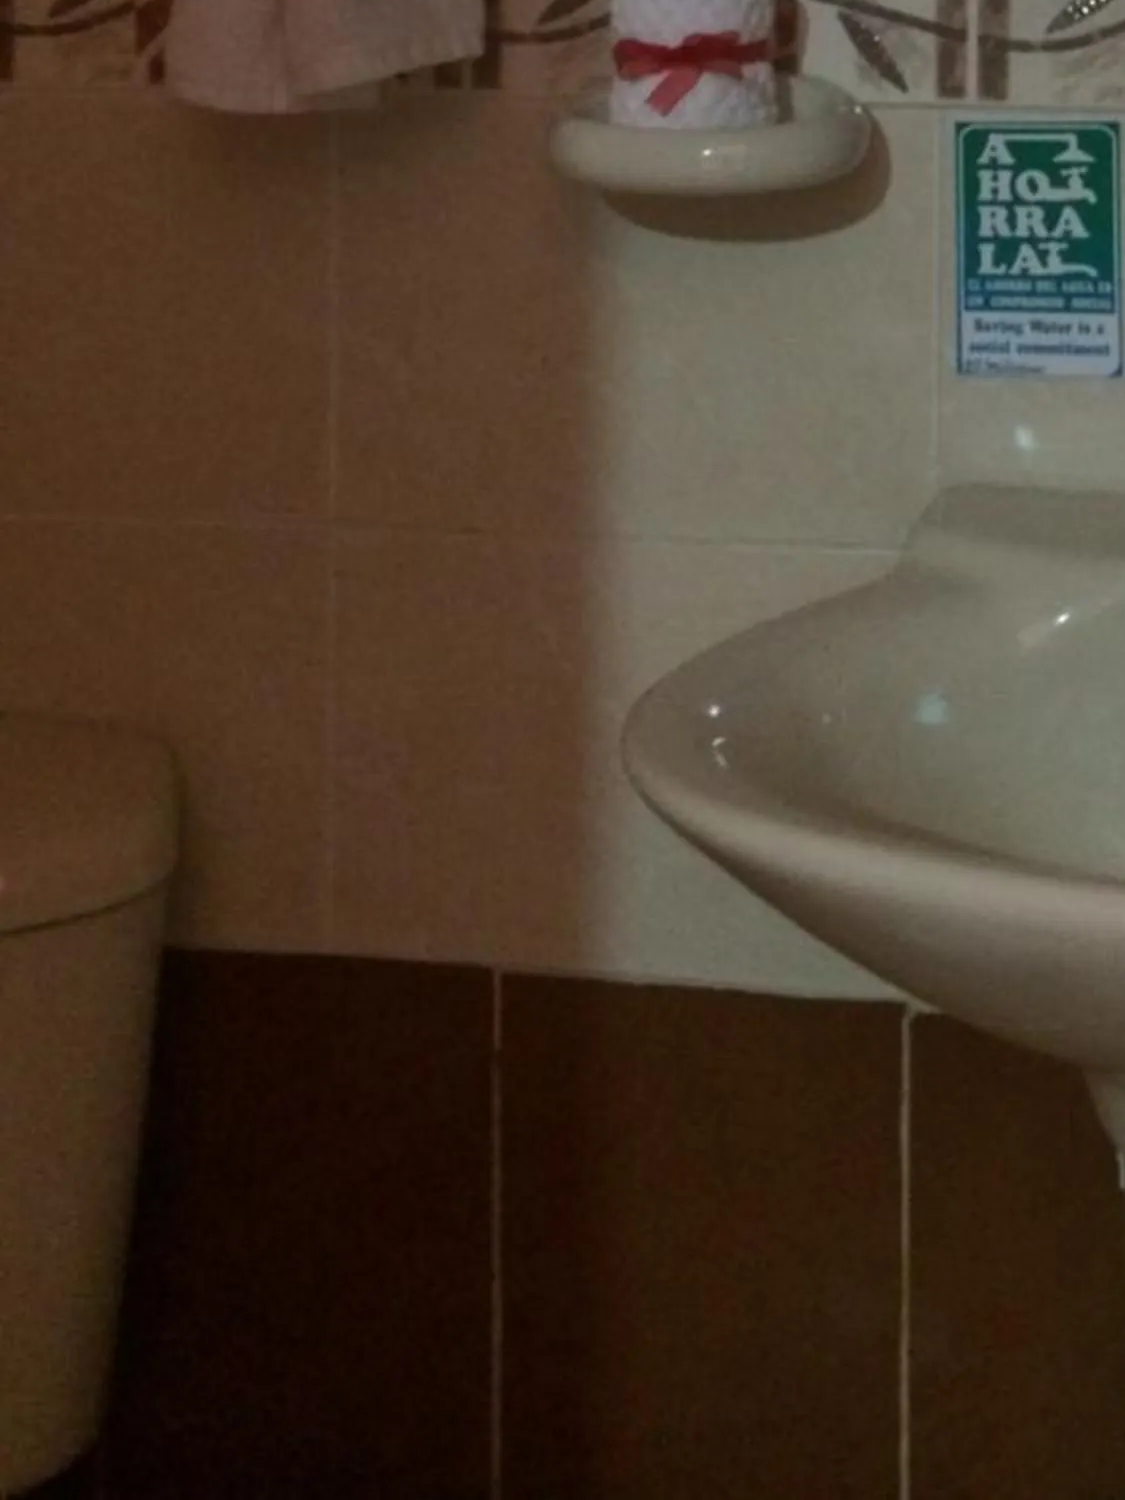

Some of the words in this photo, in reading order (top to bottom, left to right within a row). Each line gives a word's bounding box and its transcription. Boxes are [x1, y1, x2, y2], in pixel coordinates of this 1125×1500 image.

[977, 132, 1015, 165] A
[977, 205, 1090, 238] RRA
[1029, 318, 1073, 335] Water
